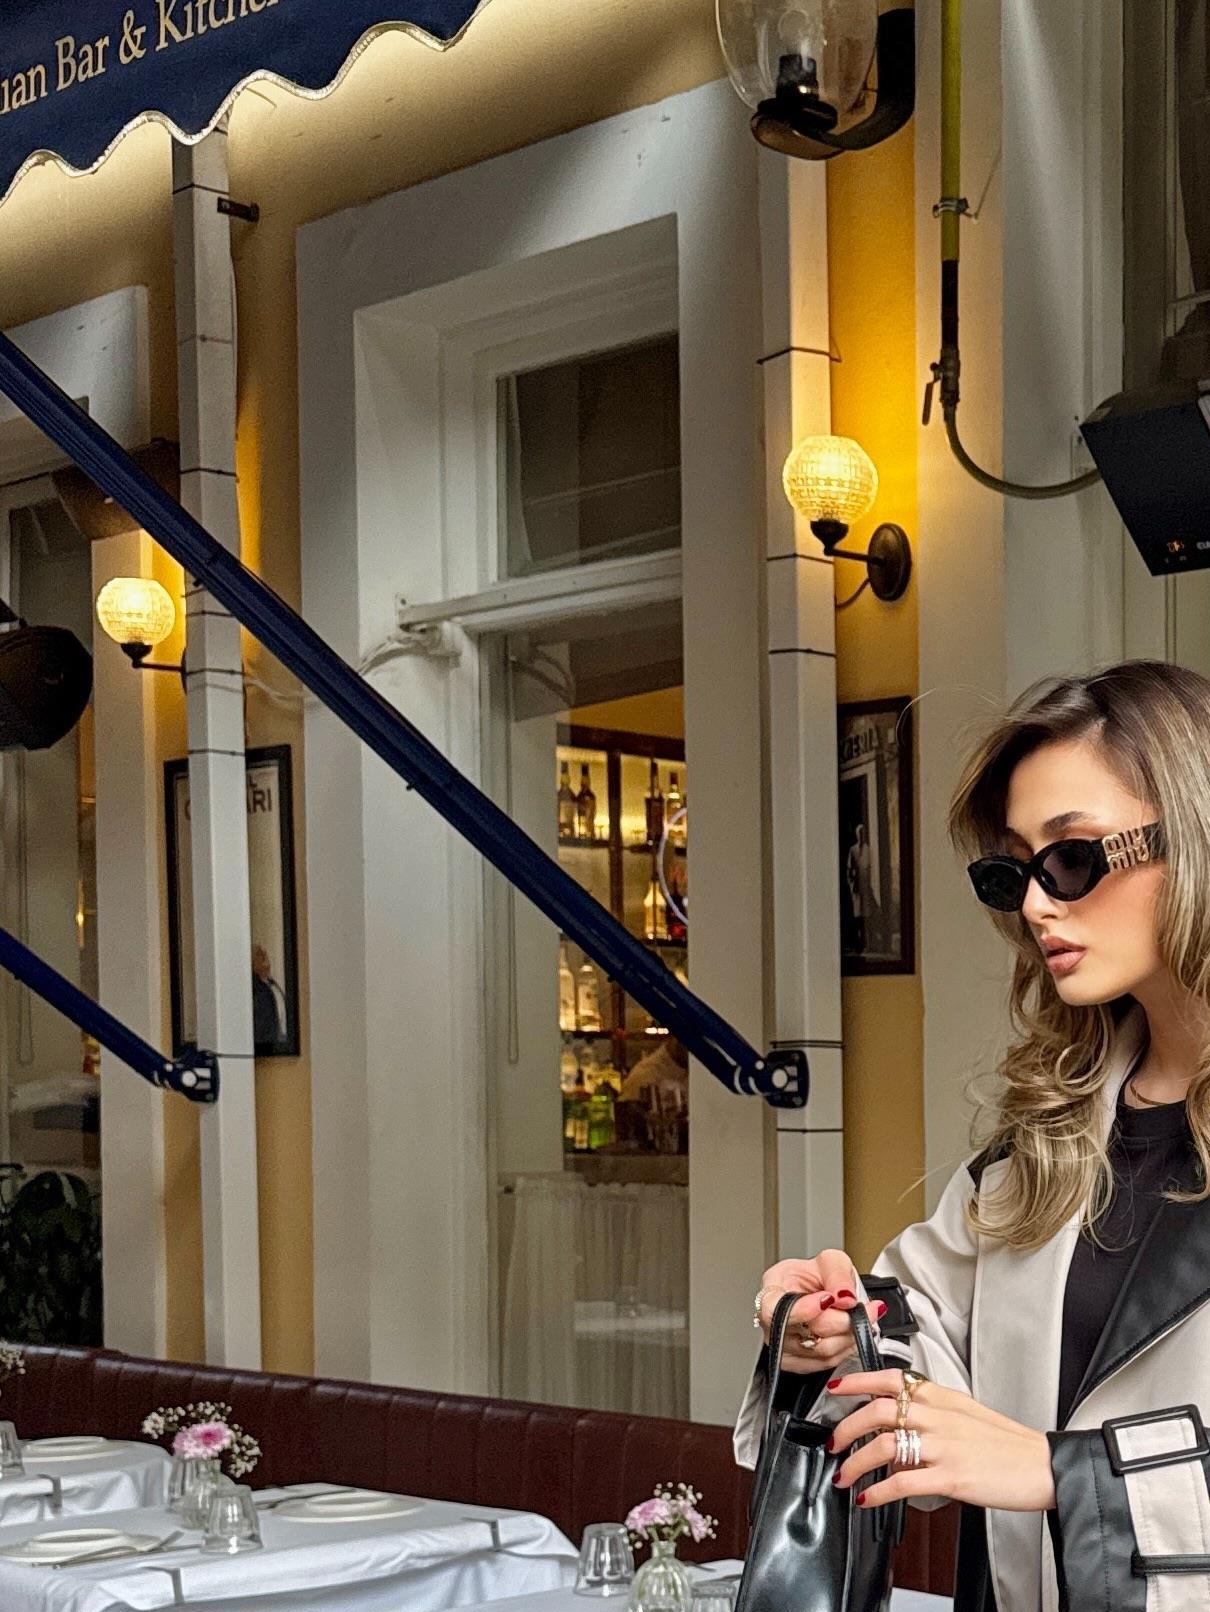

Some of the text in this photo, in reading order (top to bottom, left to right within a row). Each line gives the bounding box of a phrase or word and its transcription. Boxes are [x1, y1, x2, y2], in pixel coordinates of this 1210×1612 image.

[55, 35, 110, 92] Bar
[119, 9, 147, 65] &
[154, 0, 279, 51] Kitc
